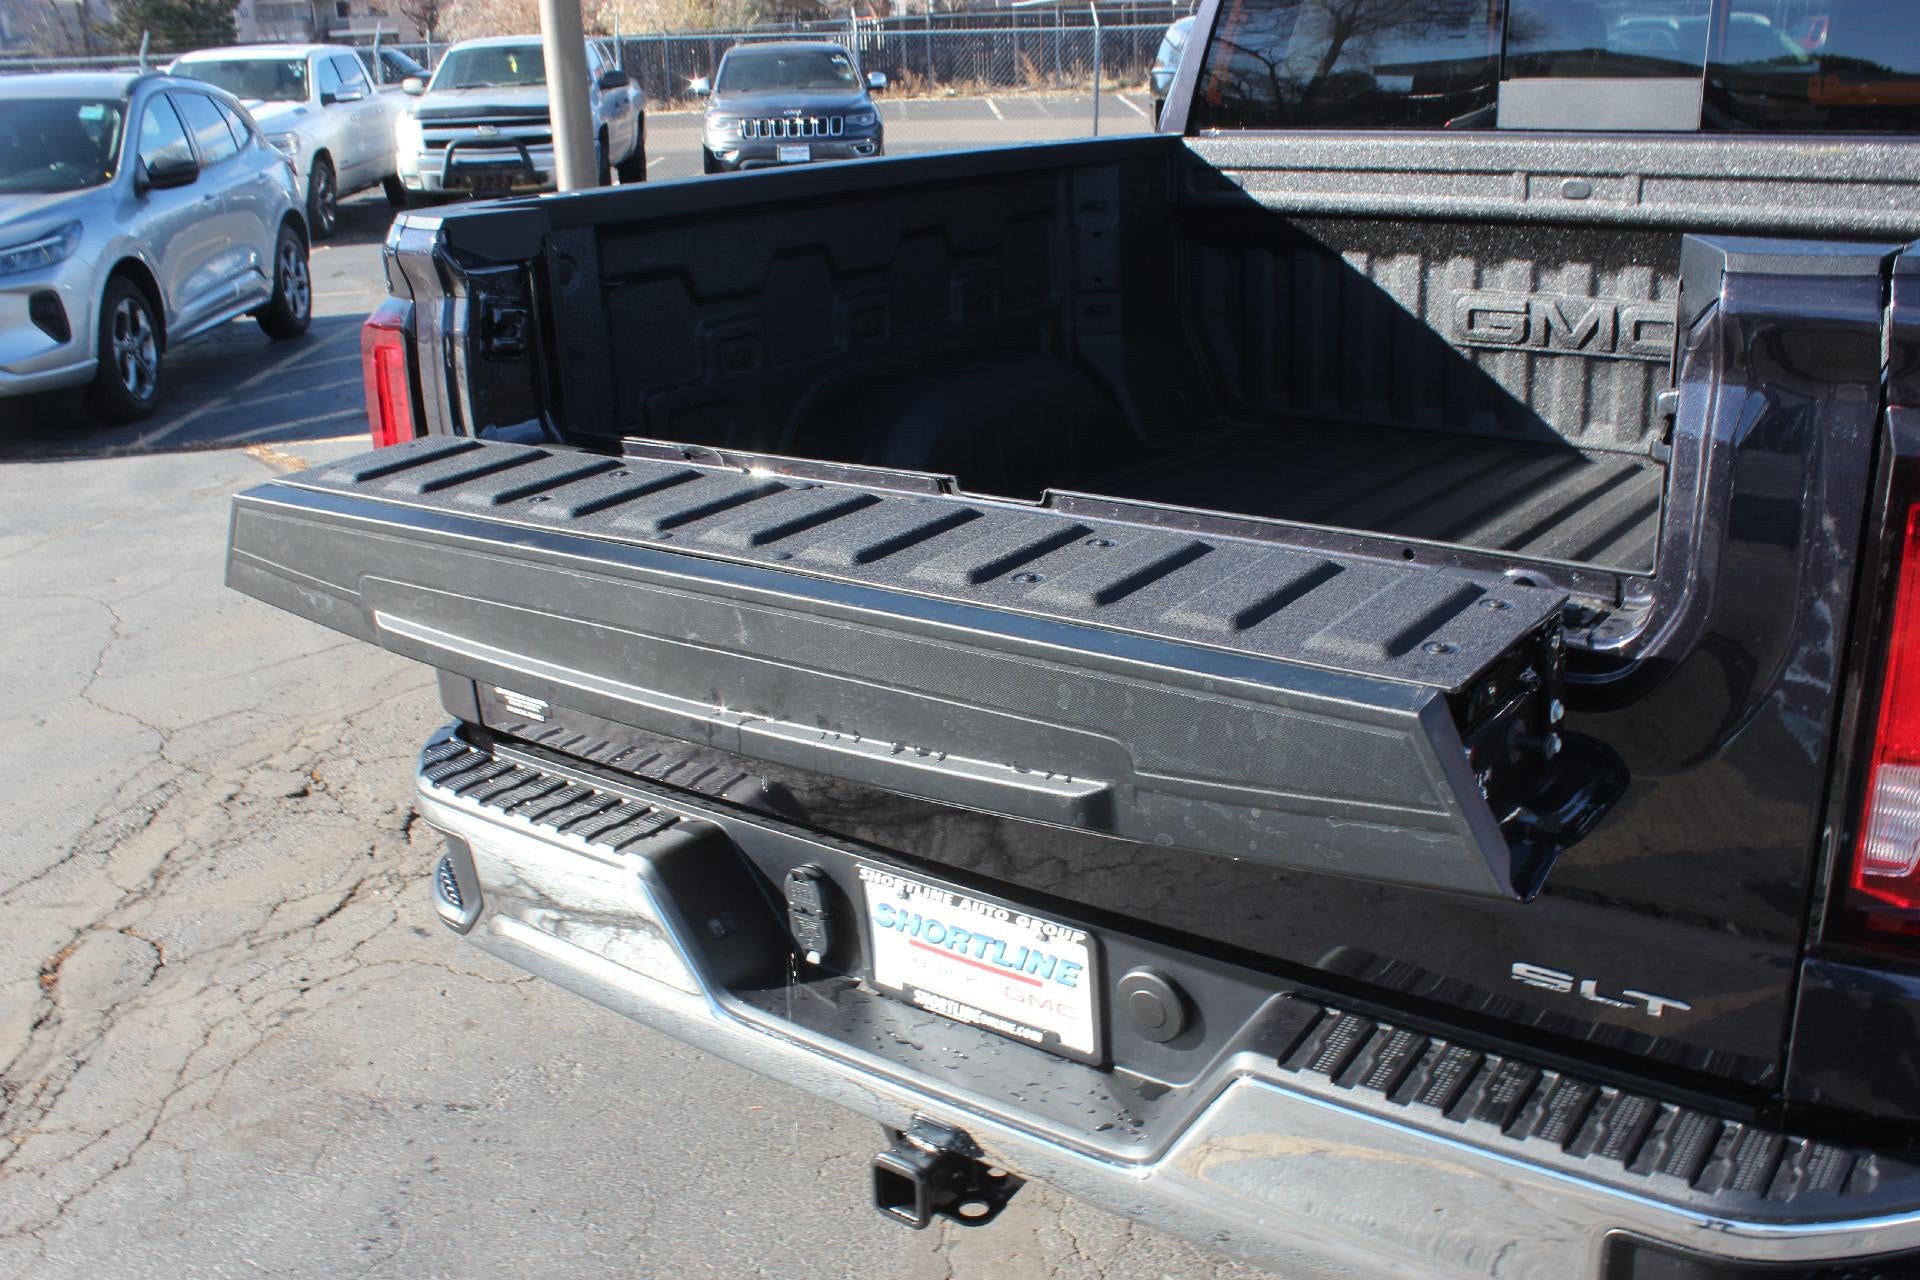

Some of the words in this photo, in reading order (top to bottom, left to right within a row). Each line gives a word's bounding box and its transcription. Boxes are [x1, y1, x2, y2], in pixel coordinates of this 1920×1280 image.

[1455, 293, 1676, 356] GMC
[858, 867, 955, 907] SHORTLINE
[960, 899, 1010, 923] AUTO
[1015, 914, 1086, 944] GROUP
[873, 901, 1084, 989] SHORTLINE
[1004, 986, 1078, 1020] GMC
[1511, 962, 1692, 1018] SLT
